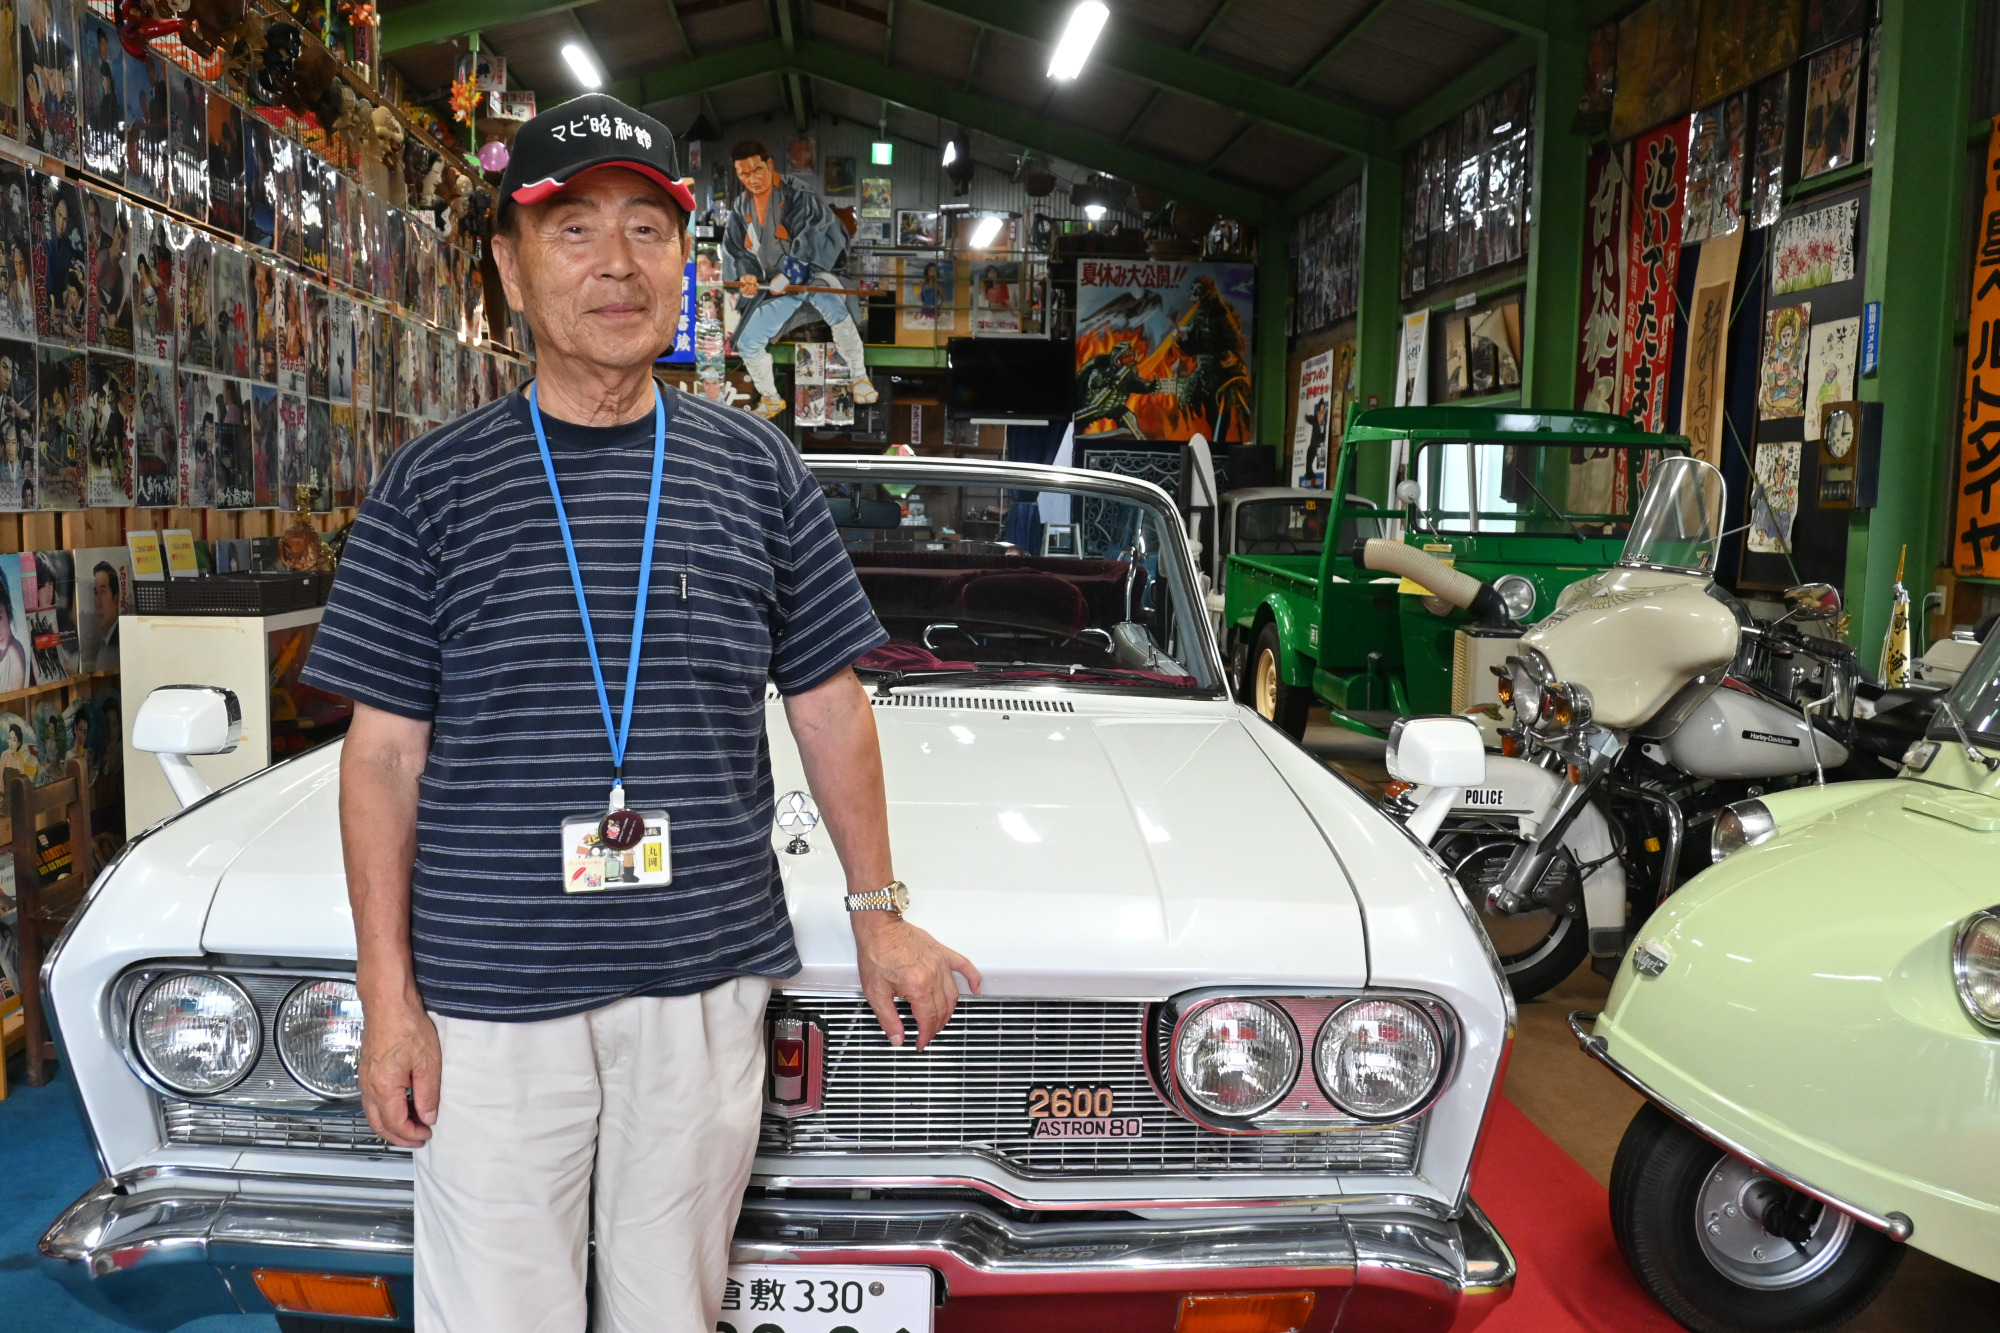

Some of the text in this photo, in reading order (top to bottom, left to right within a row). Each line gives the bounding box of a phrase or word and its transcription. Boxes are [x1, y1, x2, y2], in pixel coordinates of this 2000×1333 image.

[551, 113, 652, 149] マビ昭和館
[1080, 262, 1188, 289] 夏休み大公開!!
[1750, 732, 1793, 745] Harley-Davidson
[1465, 789, 1504, 805] POLICE
[1029, 1088, 1113, 1118] 2600
[1037, 1119, 1140, 1136] ASTRON 80
[793, 1279, 863, 1314] 330
